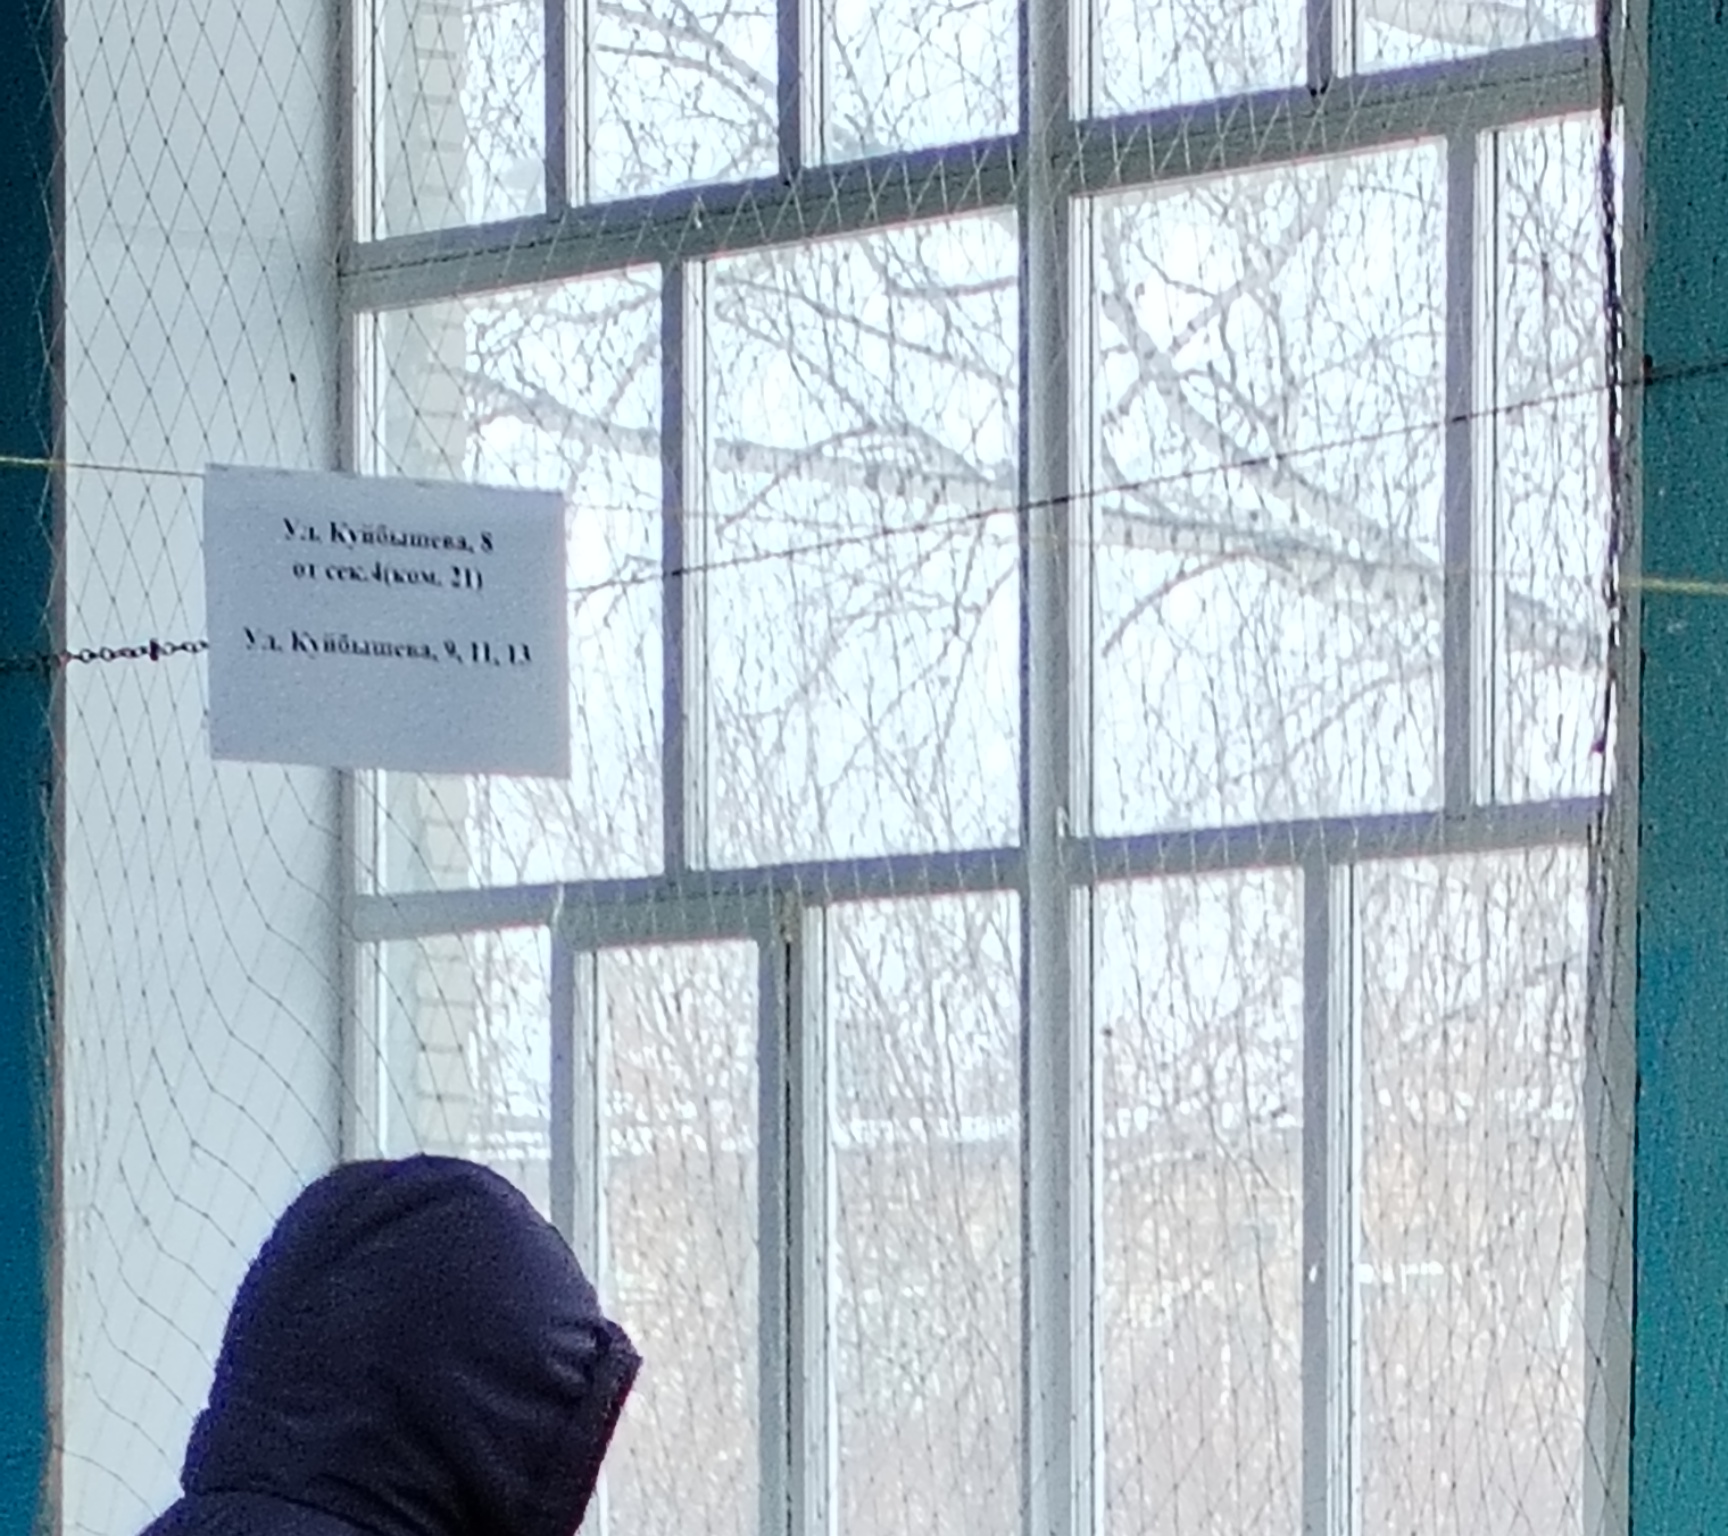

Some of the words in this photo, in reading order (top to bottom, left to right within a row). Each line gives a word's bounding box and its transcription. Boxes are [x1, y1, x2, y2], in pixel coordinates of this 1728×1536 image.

[283, 517, 322, 544] Ул.
[330, 521, 475, 554] Куйбышева,
[480, 530, 494, 554] 8
[292, 562, 317, 580] от
[451, 565, 483, 591] 21)
[244, 626, 283, 652] Ул.
[291, 630, 439, 662] Куйбышева,
[443, 639, 463, 664] 9,
[471, 641, 499, 666] 11,
[508, 643, 531, 665] 13
